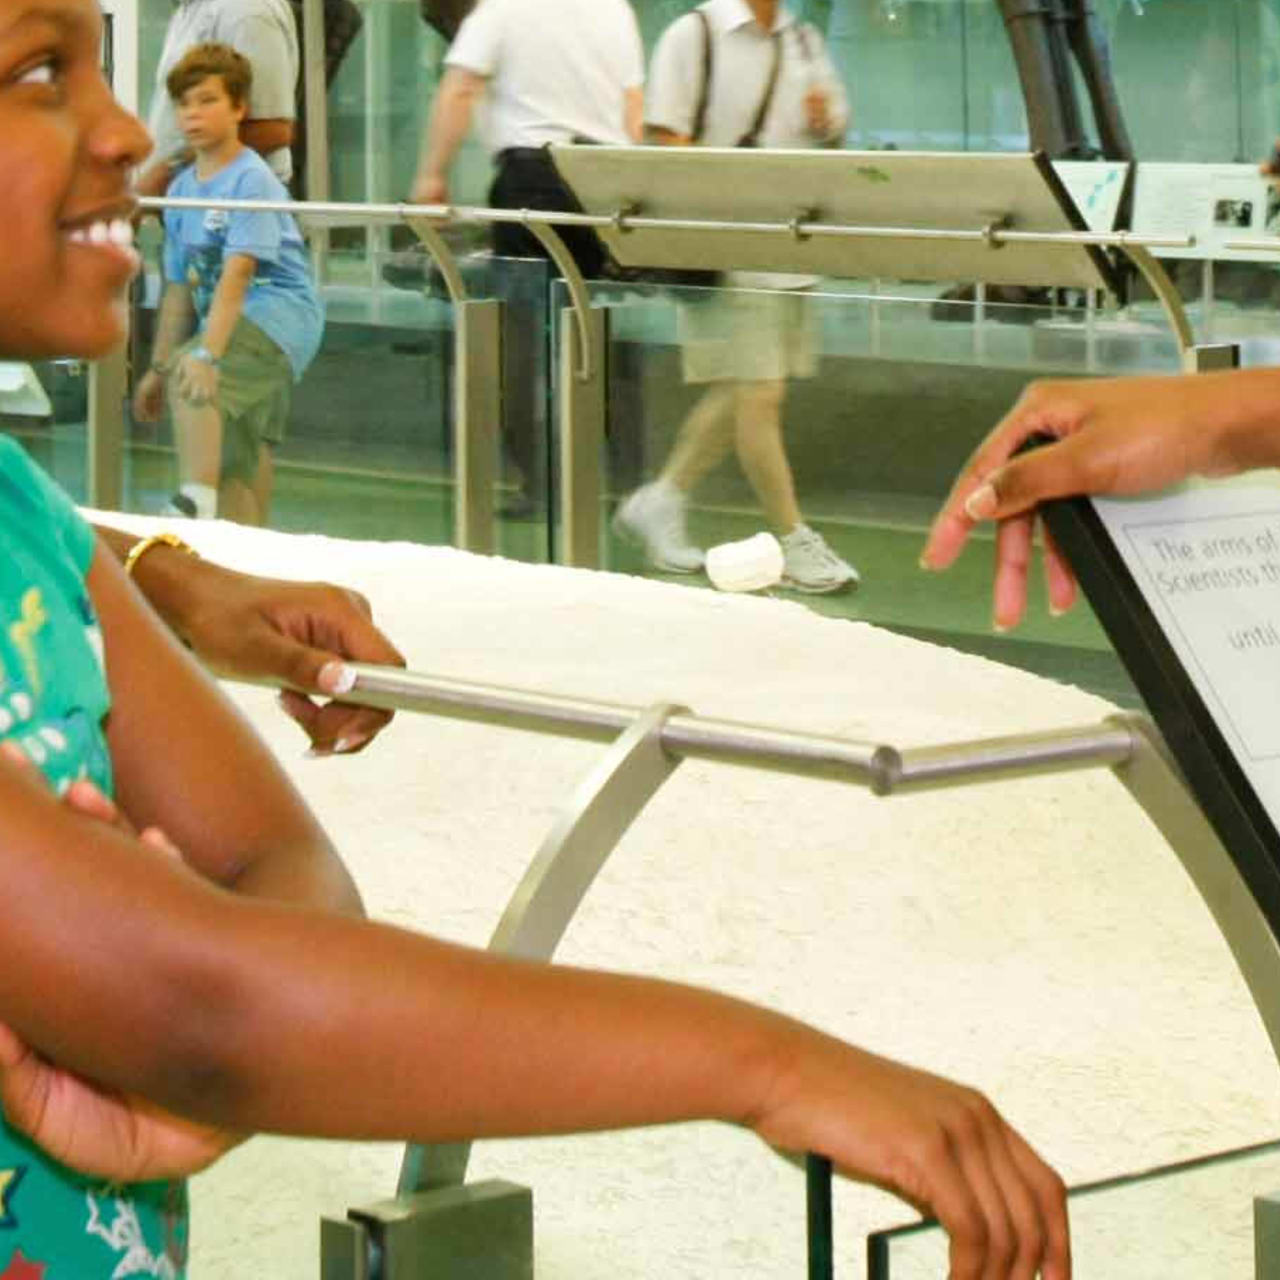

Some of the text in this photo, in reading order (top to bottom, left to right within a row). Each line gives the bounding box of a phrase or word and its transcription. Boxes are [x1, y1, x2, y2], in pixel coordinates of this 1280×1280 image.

[1153, 537, 1193, 561] The
[1202, 537, 1254, 557] arms
[1256, 529, 1276, 551] of
[1156, 568, 1259, 592] Scientists
